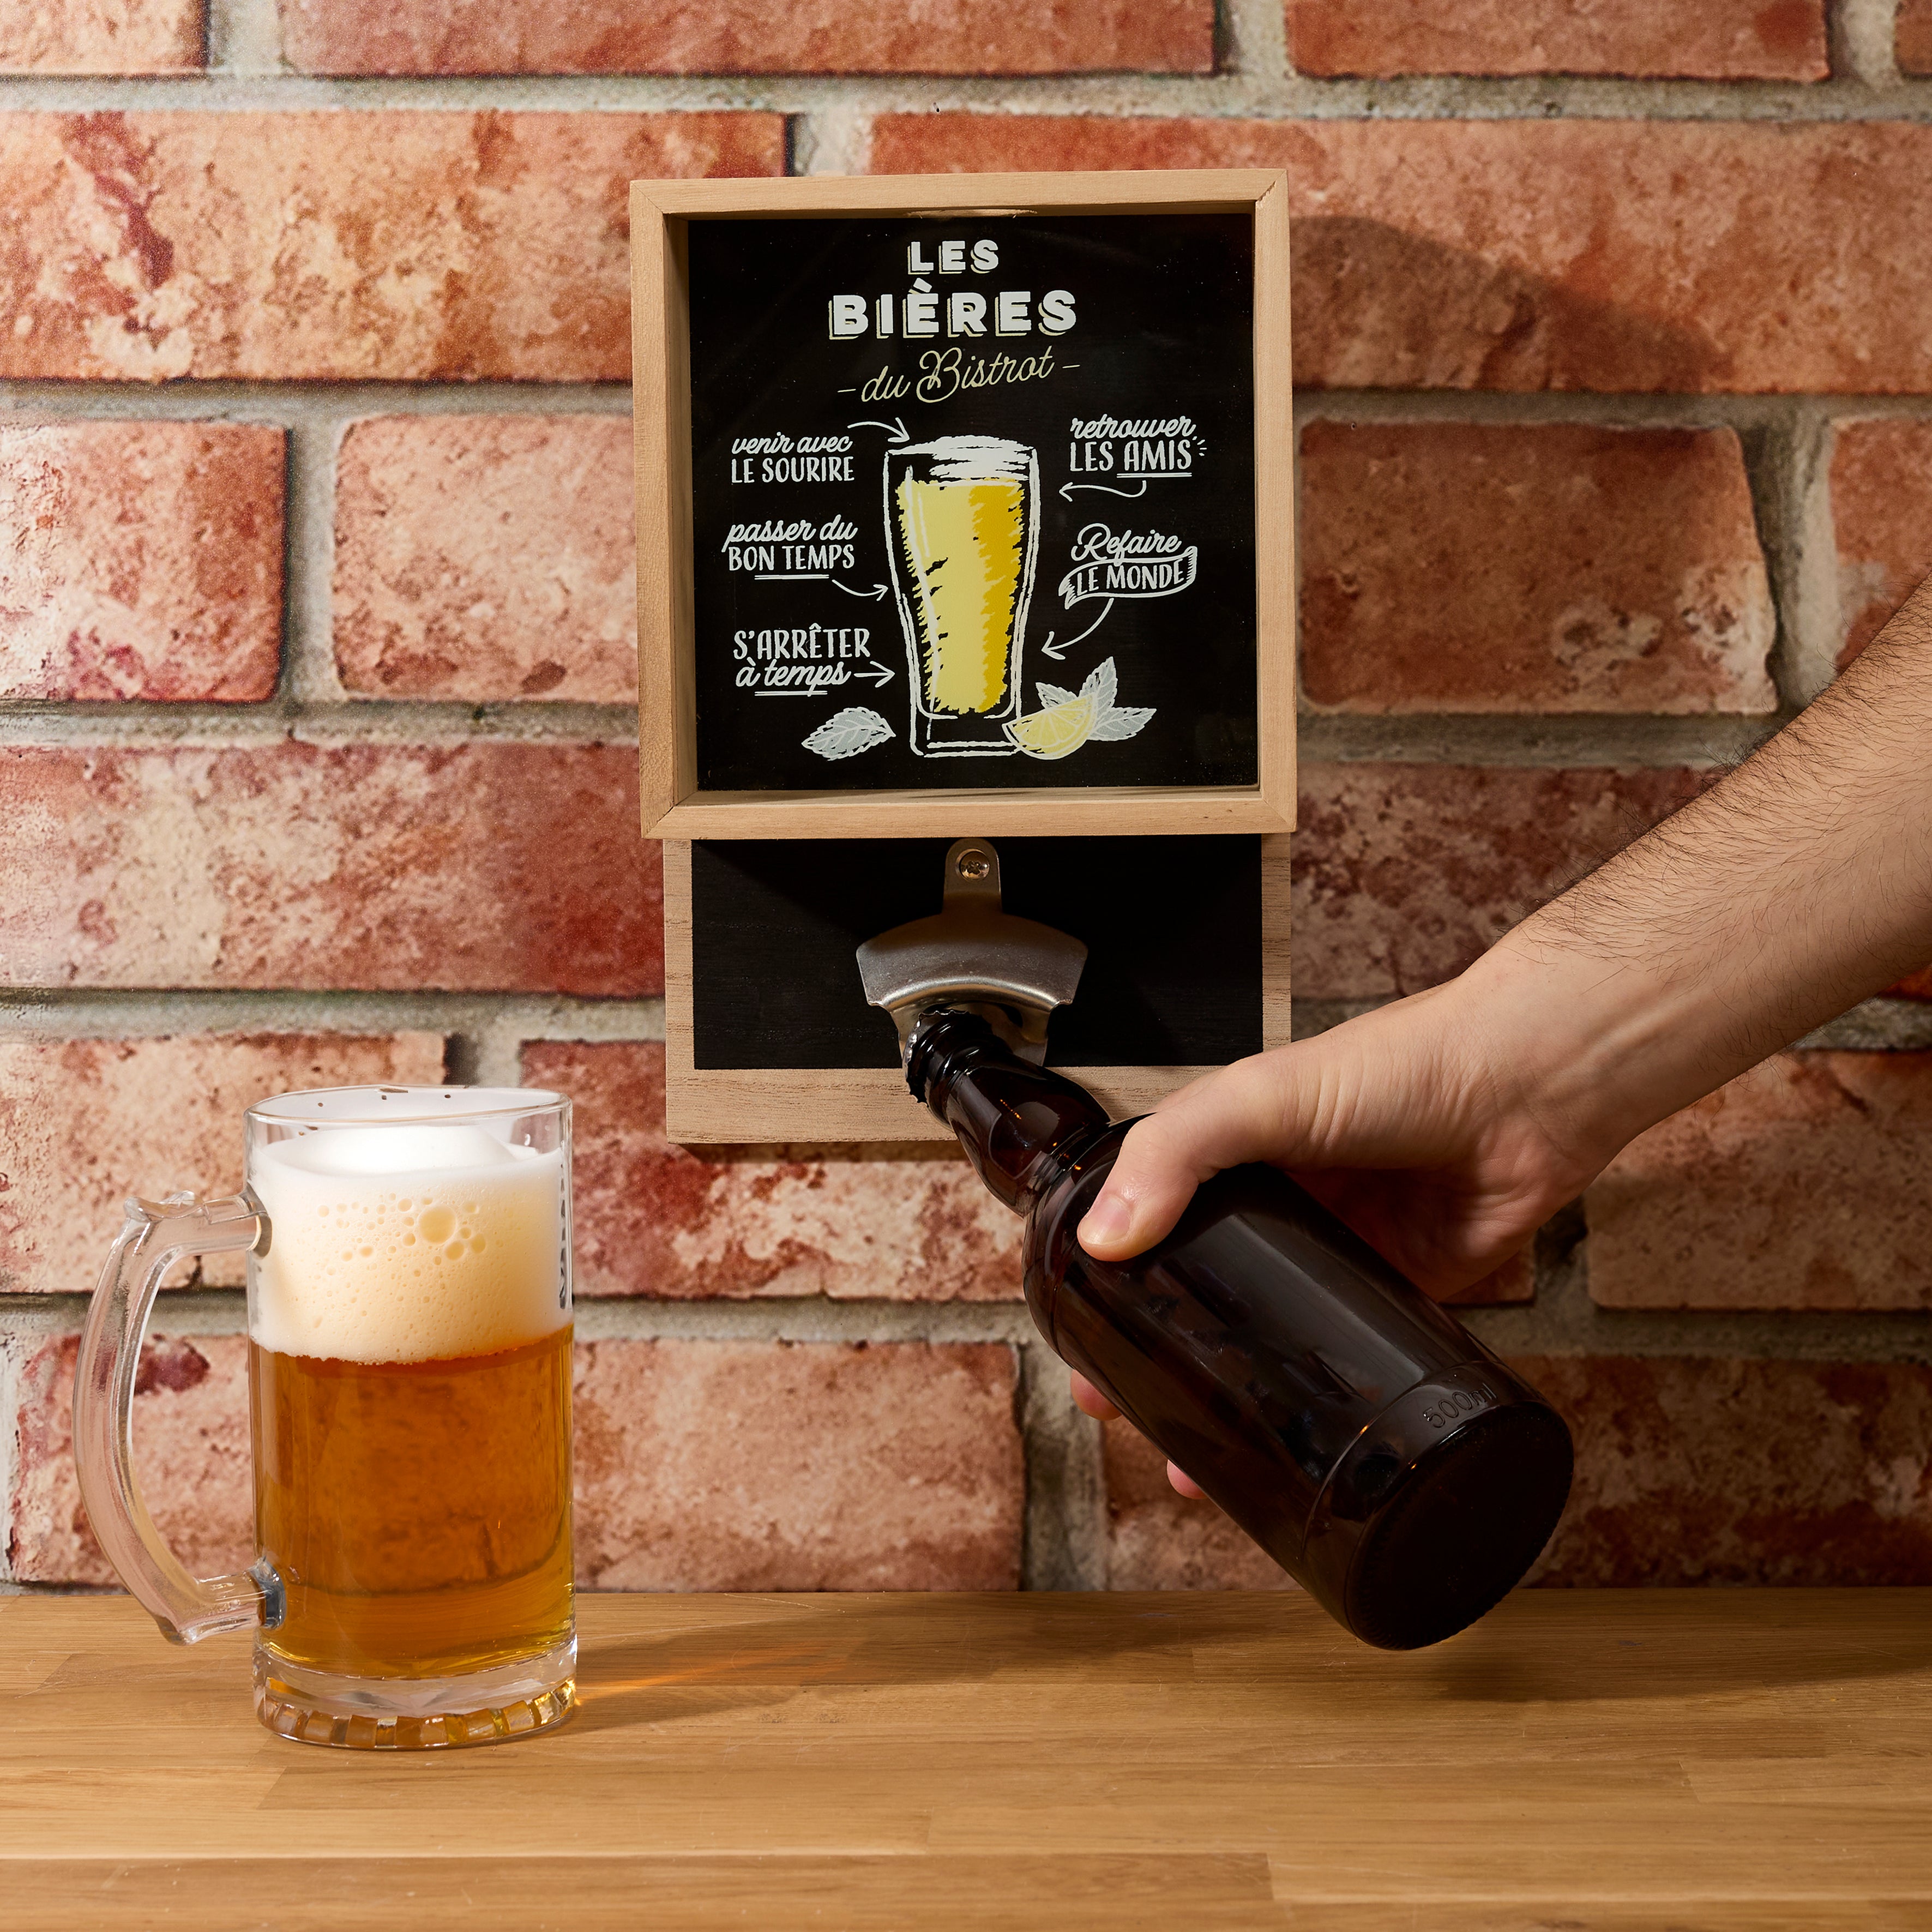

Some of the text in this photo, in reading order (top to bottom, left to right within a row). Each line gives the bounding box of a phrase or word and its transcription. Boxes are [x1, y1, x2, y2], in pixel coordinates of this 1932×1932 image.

[907, 240, 999, 275] LES
[828, 278, 1076, 340] BIÈRES
[861, 345, 1055, 404] du Bistrot
[731, 431, 853, 454] venir avec
[1070, 413, 1196, 439] retrouver
[731, 456, 855, 483] LE SOURIRE
[1070, 440, 1192, 472] LES AMIS
[721, 514, 858, 553] passer du
[1070, 522, 1182, 567] Refaire
[729, 544, 855, 571] BON TEMPS
[1076, 558, 1185, 597] LE MONDE
[735, 656, 852, 697] à temps
